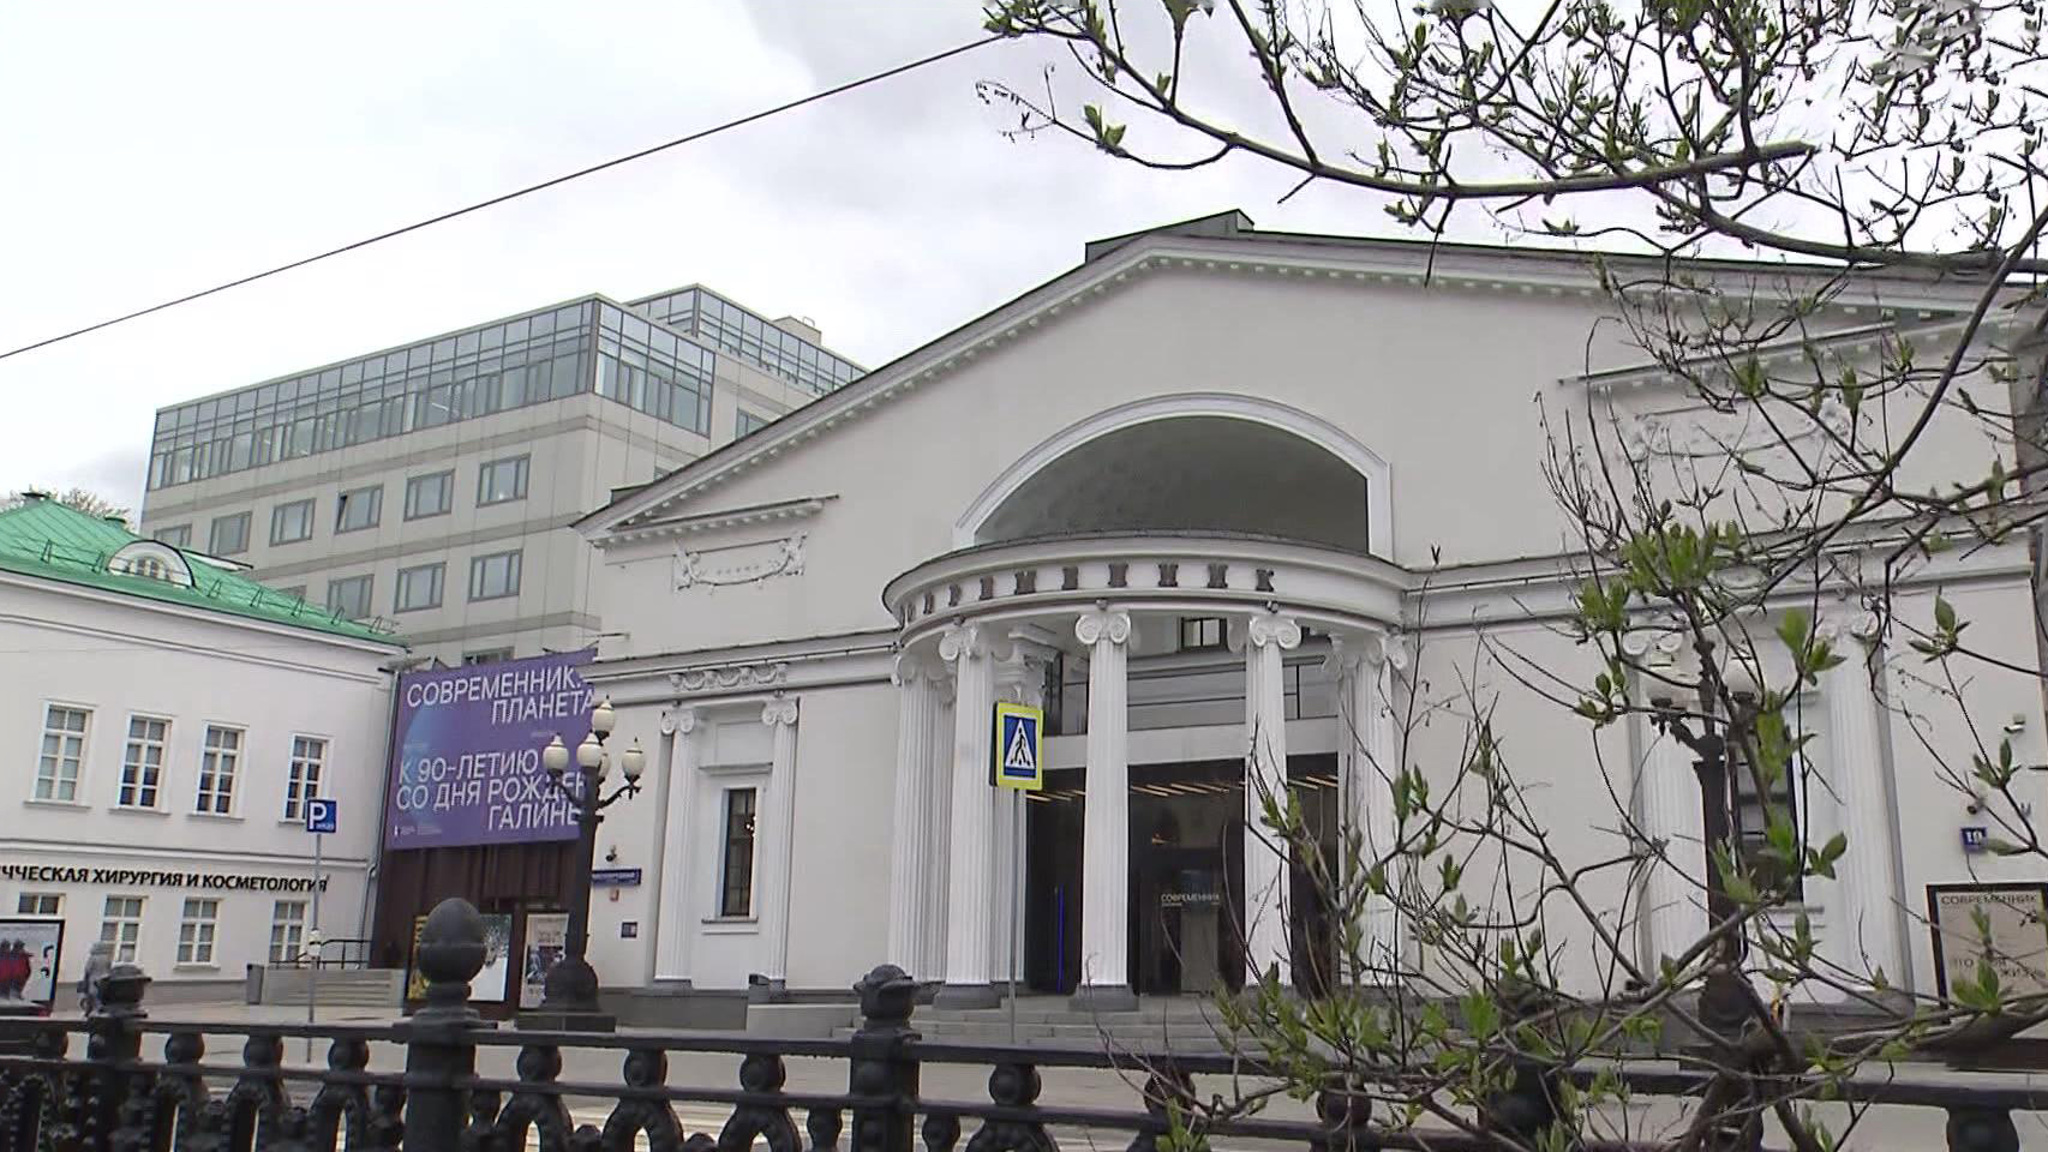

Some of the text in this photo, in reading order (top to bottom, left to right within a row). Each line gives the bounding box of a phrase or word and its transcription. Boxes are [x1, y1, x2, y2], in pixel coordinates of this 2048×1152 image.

[491, 689, 595, 725] ПЛАНЕТА
[399, 749, 538, 783] К 90-ЛЕТИЮ
[396, 785, 428, 810] СО
[433, 780, 481, 812] ДНЯ
[92, 868, 183, 887] ХИРУРГИЯ
[187, 874, 199, 887] И
[202, 874, 328, 893] КОСМЕТОЛОГИЯ
